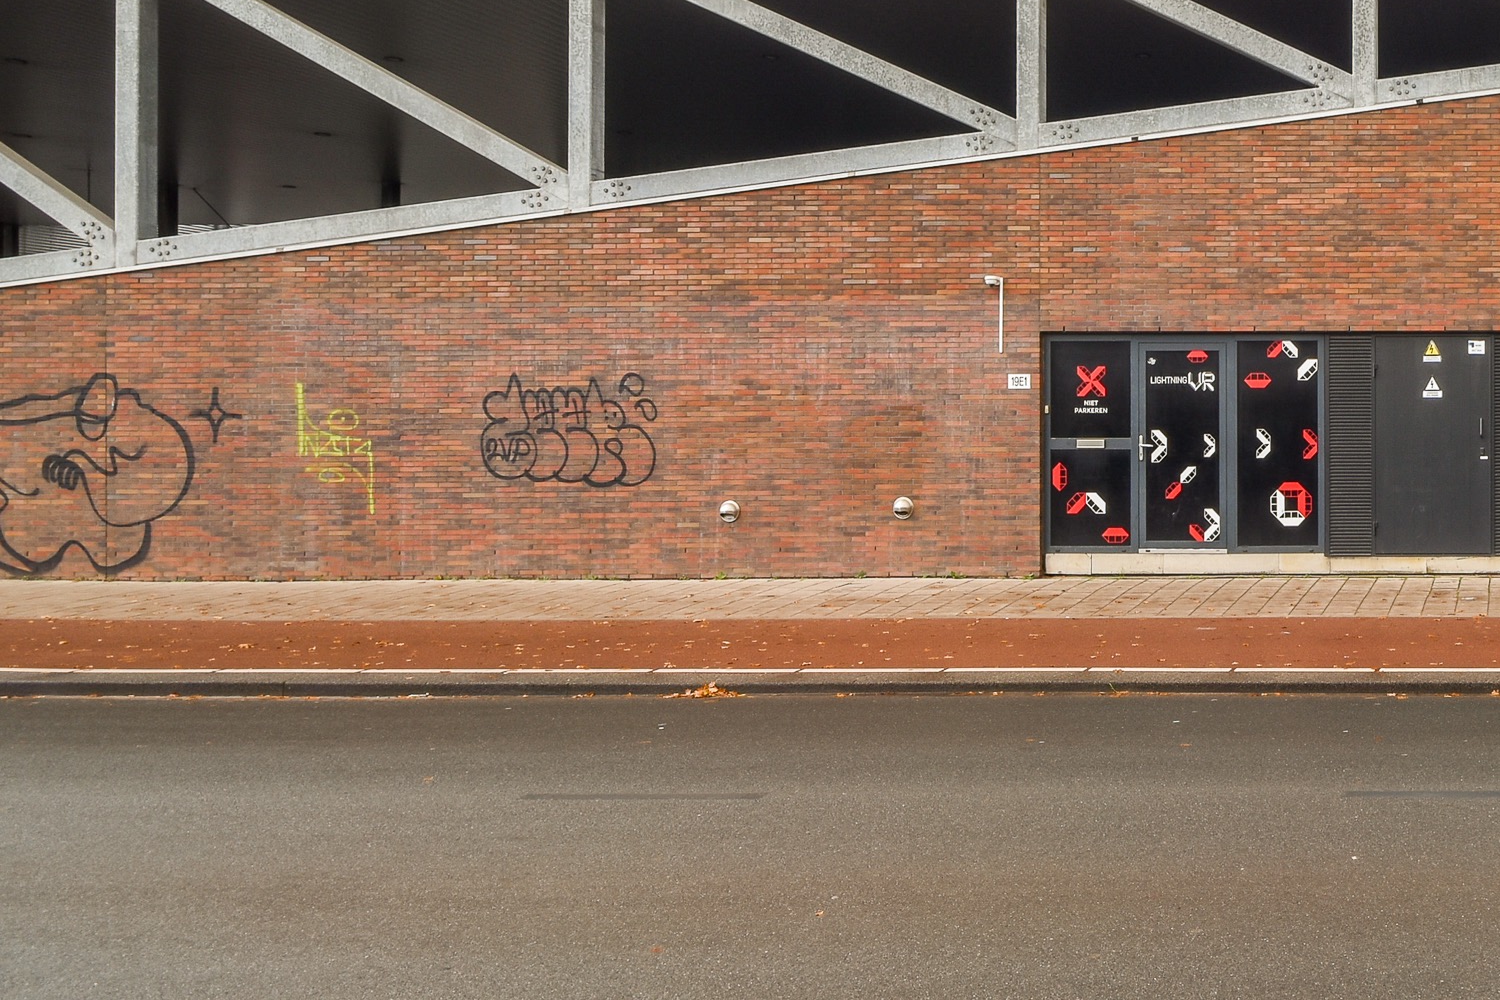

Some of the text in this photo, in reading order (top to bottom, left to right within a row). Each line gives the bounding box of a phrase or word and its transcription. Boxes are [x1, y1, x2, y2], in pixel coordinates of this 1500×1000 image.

[1011, 376, 1028, 387] 19E1
[1150, 371, 1215, 391] LIGHTNING VR
